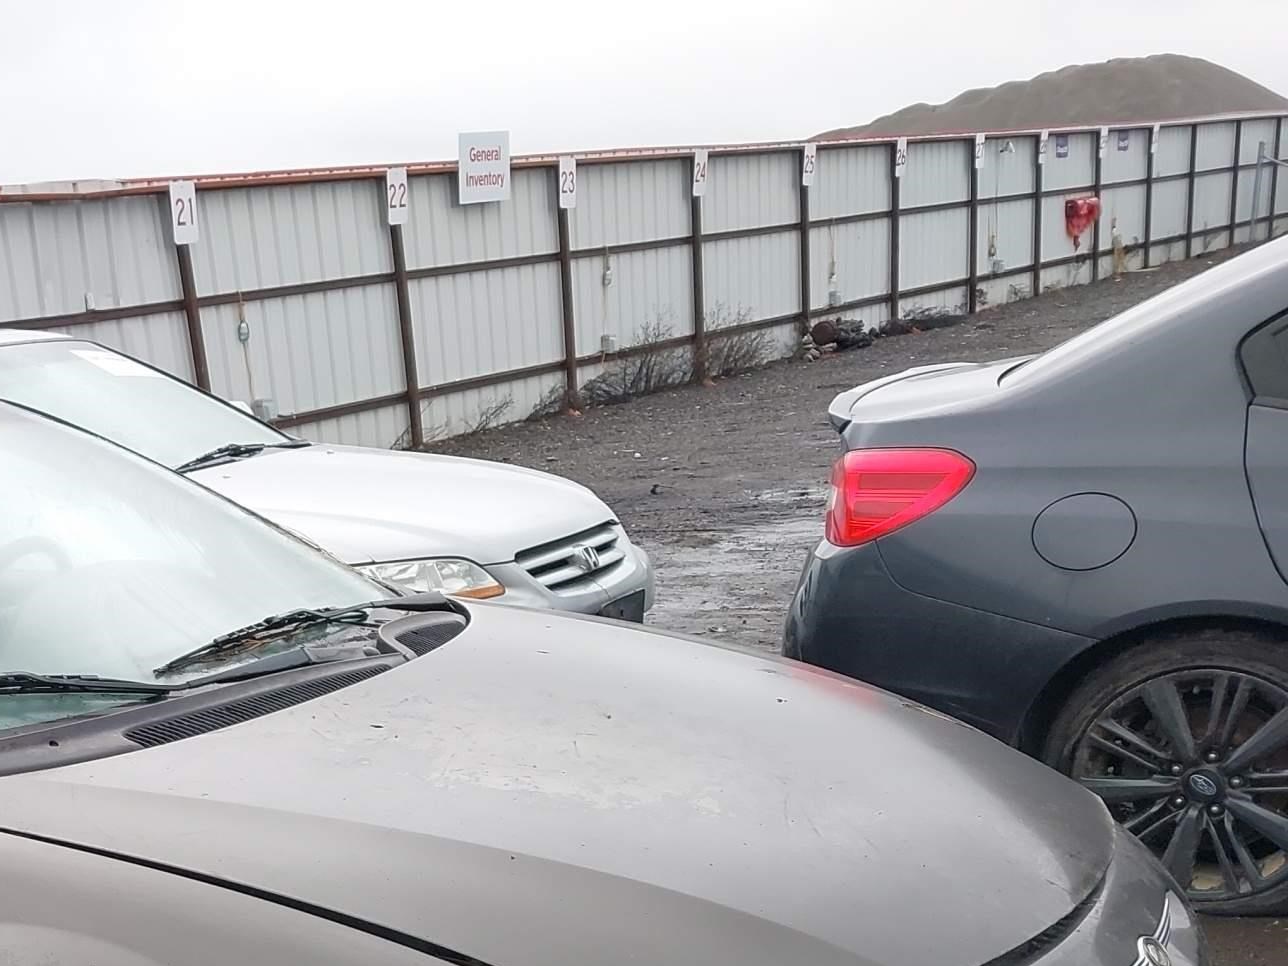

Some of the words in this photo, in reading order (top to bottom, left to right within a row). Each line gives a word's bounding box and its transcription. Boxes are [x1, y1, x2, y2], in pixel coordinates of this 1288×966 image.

[469, 145, 502, 162] General
[895, 149, 906, 166] 26
[695, 162, 706, 182] 24
[804, 154, 815, 174] 25
[465, 171, 505, 188] Inventory
[561, 171, 575, 193] 23
[389, 183, 407, 208] 22
[175, 198, 194, 226] 21
